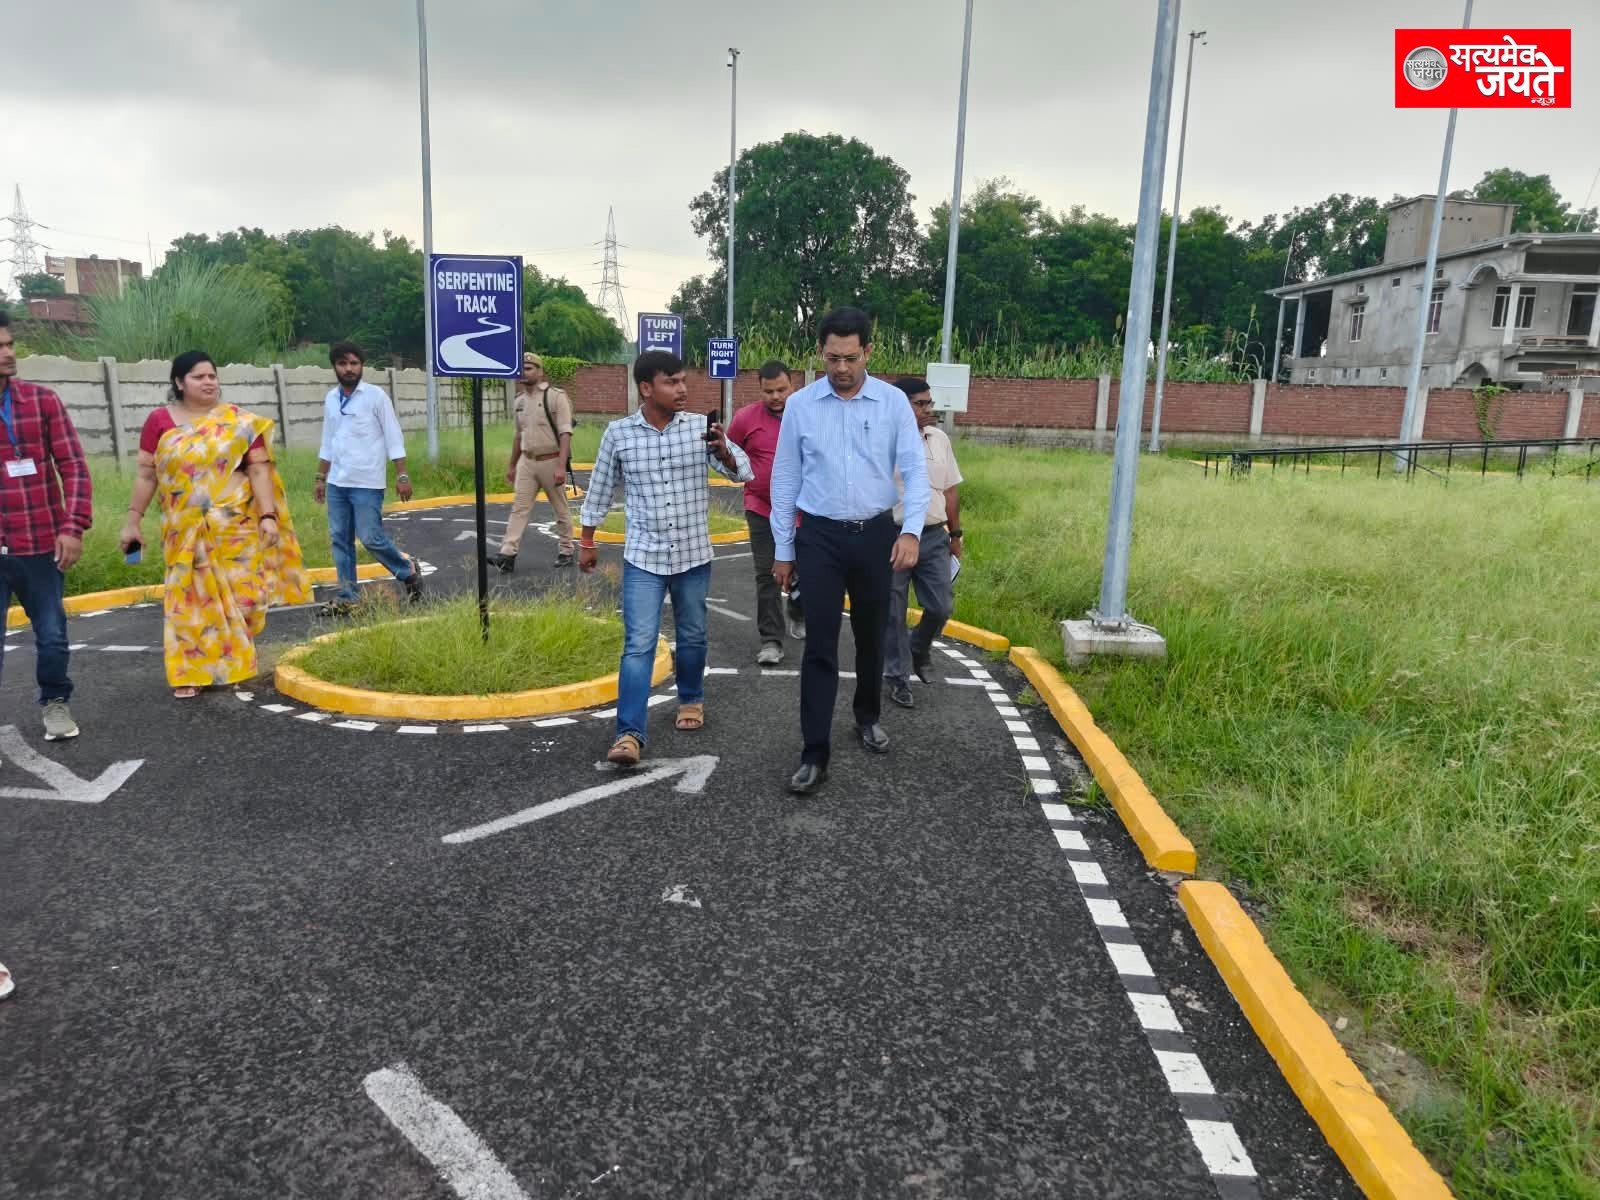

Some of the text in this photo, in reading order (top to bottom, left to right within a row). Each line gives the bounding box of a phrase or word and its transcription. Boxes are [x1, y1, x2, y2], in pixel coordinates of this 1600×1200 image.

[437, 271, 514, 292] SERPENTINE
[455, 294, 497, 314] TRACK
[645, 318, 677, 330] TURN
[647, 331, 675, 343] LEFT
[712, 342, 734, 350] TURN
[711, 350, 735, 358] RIGHT
